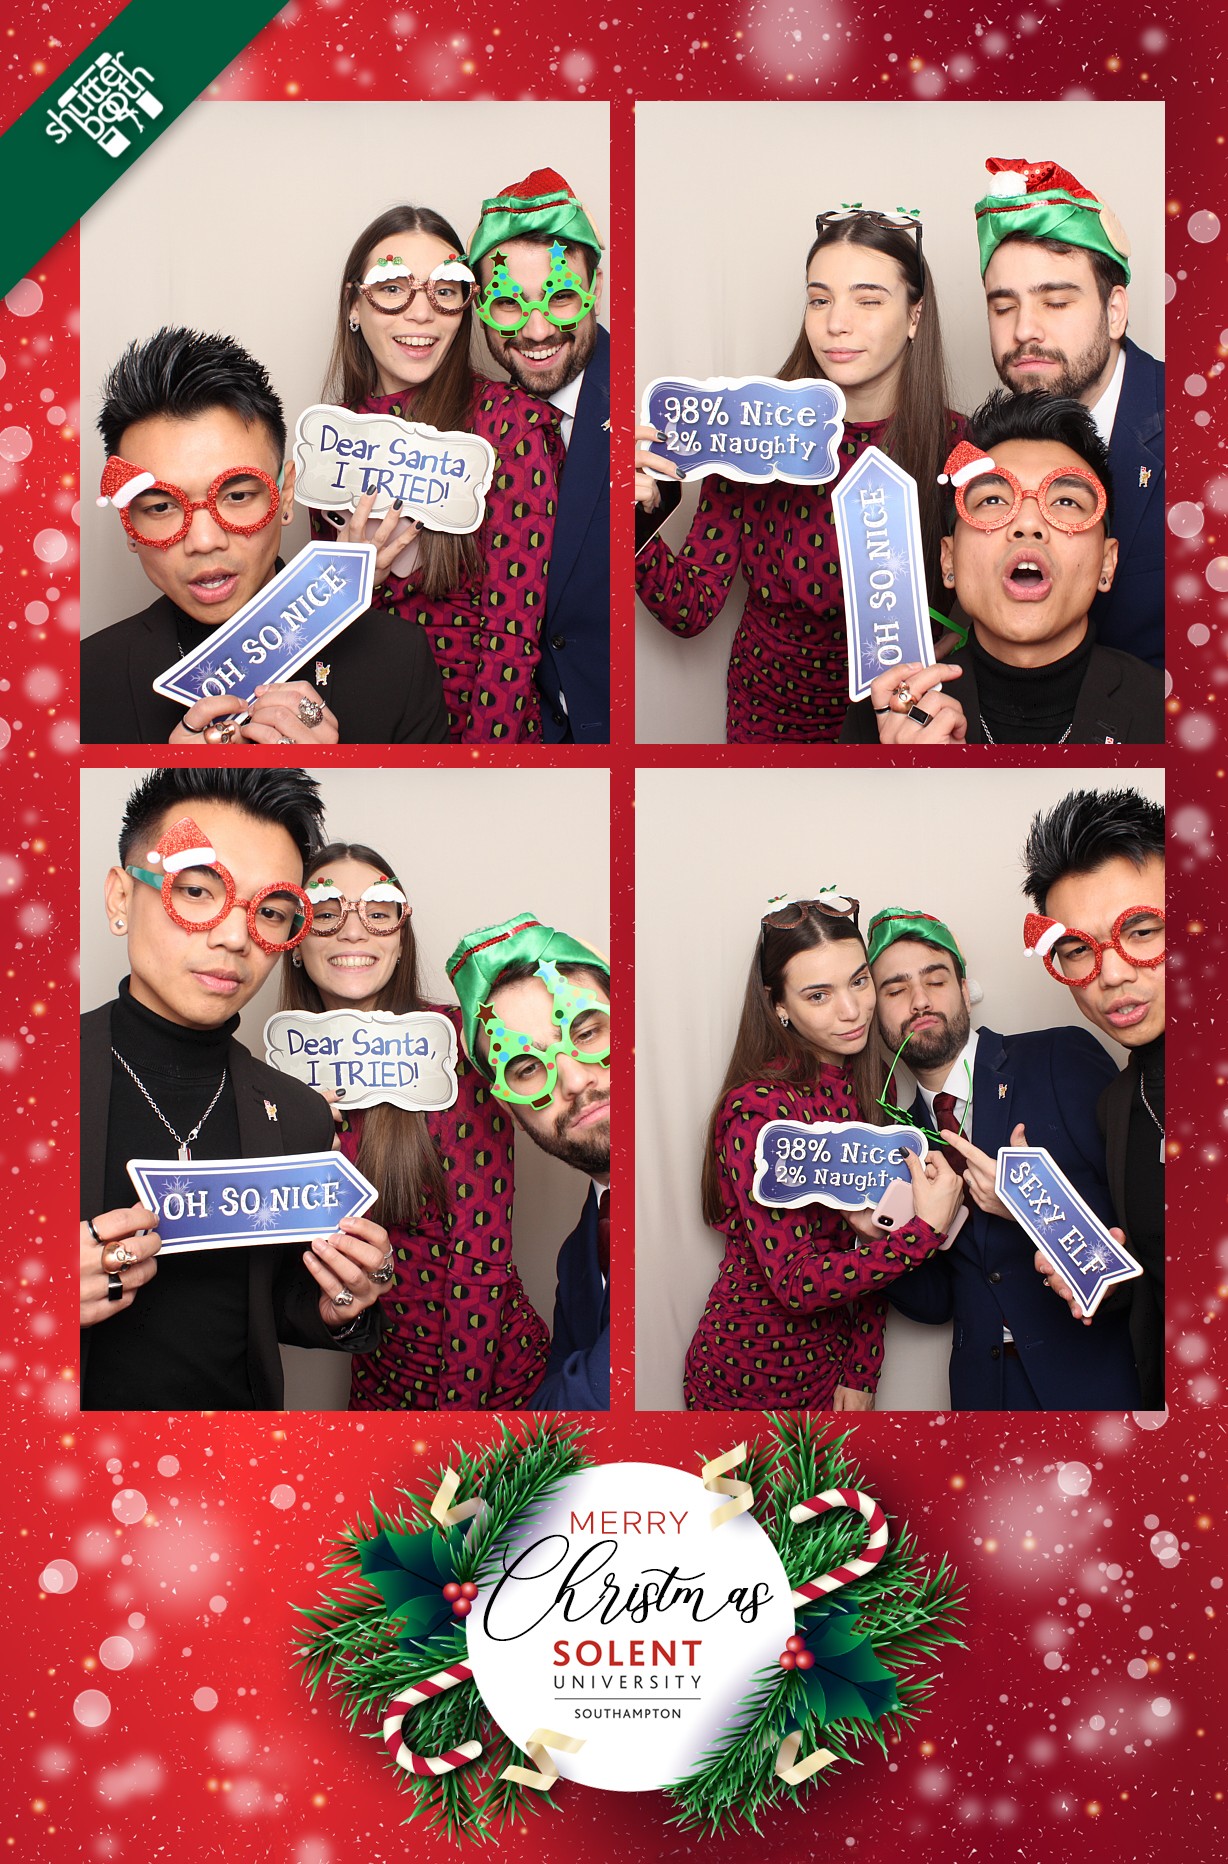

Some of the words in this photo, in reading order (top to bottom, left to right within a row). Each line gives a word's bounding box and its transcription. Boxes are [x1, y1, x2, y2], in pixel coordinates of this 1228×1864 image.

[664, 396, 730, 426] 98%
[740, 400, 817, 427] Nice
[320, 424, 380, 461] Dear
[388, 438, 471, 482] Santa,
[666, 430, 702, 452] 2%
[710, 433, 817, 461] Naughty
[331, 461, 350, 489] I
[359, 467, 450, 508] TRIED!
[860, 487, 891, 561] NICE
[869, 569, 897, 611] SO
[201, 658, 246, 697] OH
[241, 625, 283, 664] SO
[280, 564, 347, 632] NICE
[874, 620, 903, 666] OH
[287, 1028, 344, 1056] Dear
[352, 1028, 436, 1060] Santa,
[307, 1060, 321, 1087] I
[329, 1060, 419, 1088] TRIED!
[776, 1137, 832, 1163] 98%
[840, 1142, 905, 1165] Nice
[776, 1165, 807, 1184] 2%
[813, 1169, 902, 1191] Naught
[163, 1190, 209, 1220] OH
[218, 1187, 263, 1216] SO
[269, 1181, 340, 1212] NICE
[1009, 1161, 1066, 1225] SEXY
[1058, 1225, 1107, 1275] ELF
